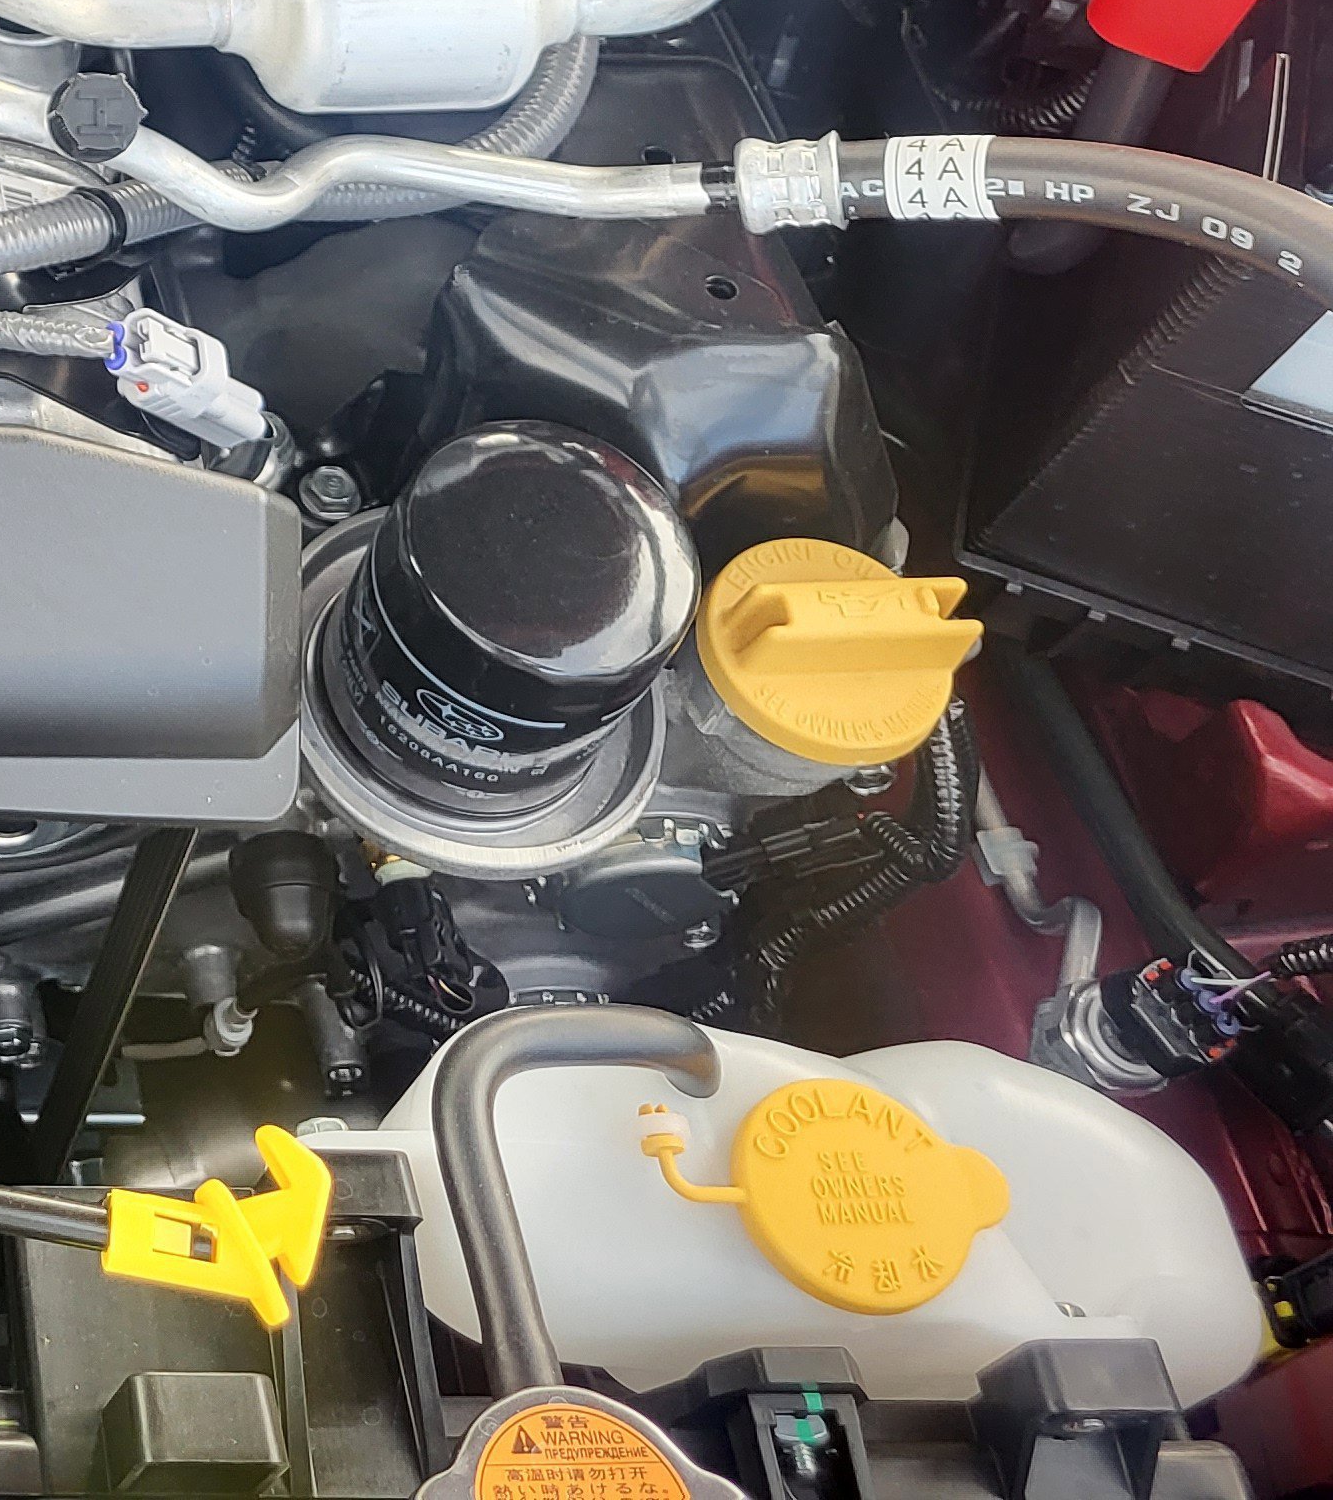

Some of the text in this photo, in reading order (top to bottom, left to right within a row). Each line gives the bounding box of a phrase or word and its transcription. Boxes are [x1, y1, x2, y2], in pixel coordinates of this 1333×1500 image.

[904, 156, 964, 181] 4 A
[907, 186, 969, 209] 4 A
[1044, 180, 1096, 204] HP
[1126, 193, 1180, 223] ZJ
[1201, 215, 1255, 251] 09
[753, 1087, 934, 1161] COOLANT
[818, 1150, 868, 1173] SEE
[811, 1174, 907, 1200] OWNERS
[816, 1200, 916, 1226] MANUAL
[540, 1414, 590, 1430] 警告
[540, 1429, 625, 1447] WARNING
[544, 1446, 650, 1462] ПРЕДУПРЕЖДЕНИЕ
